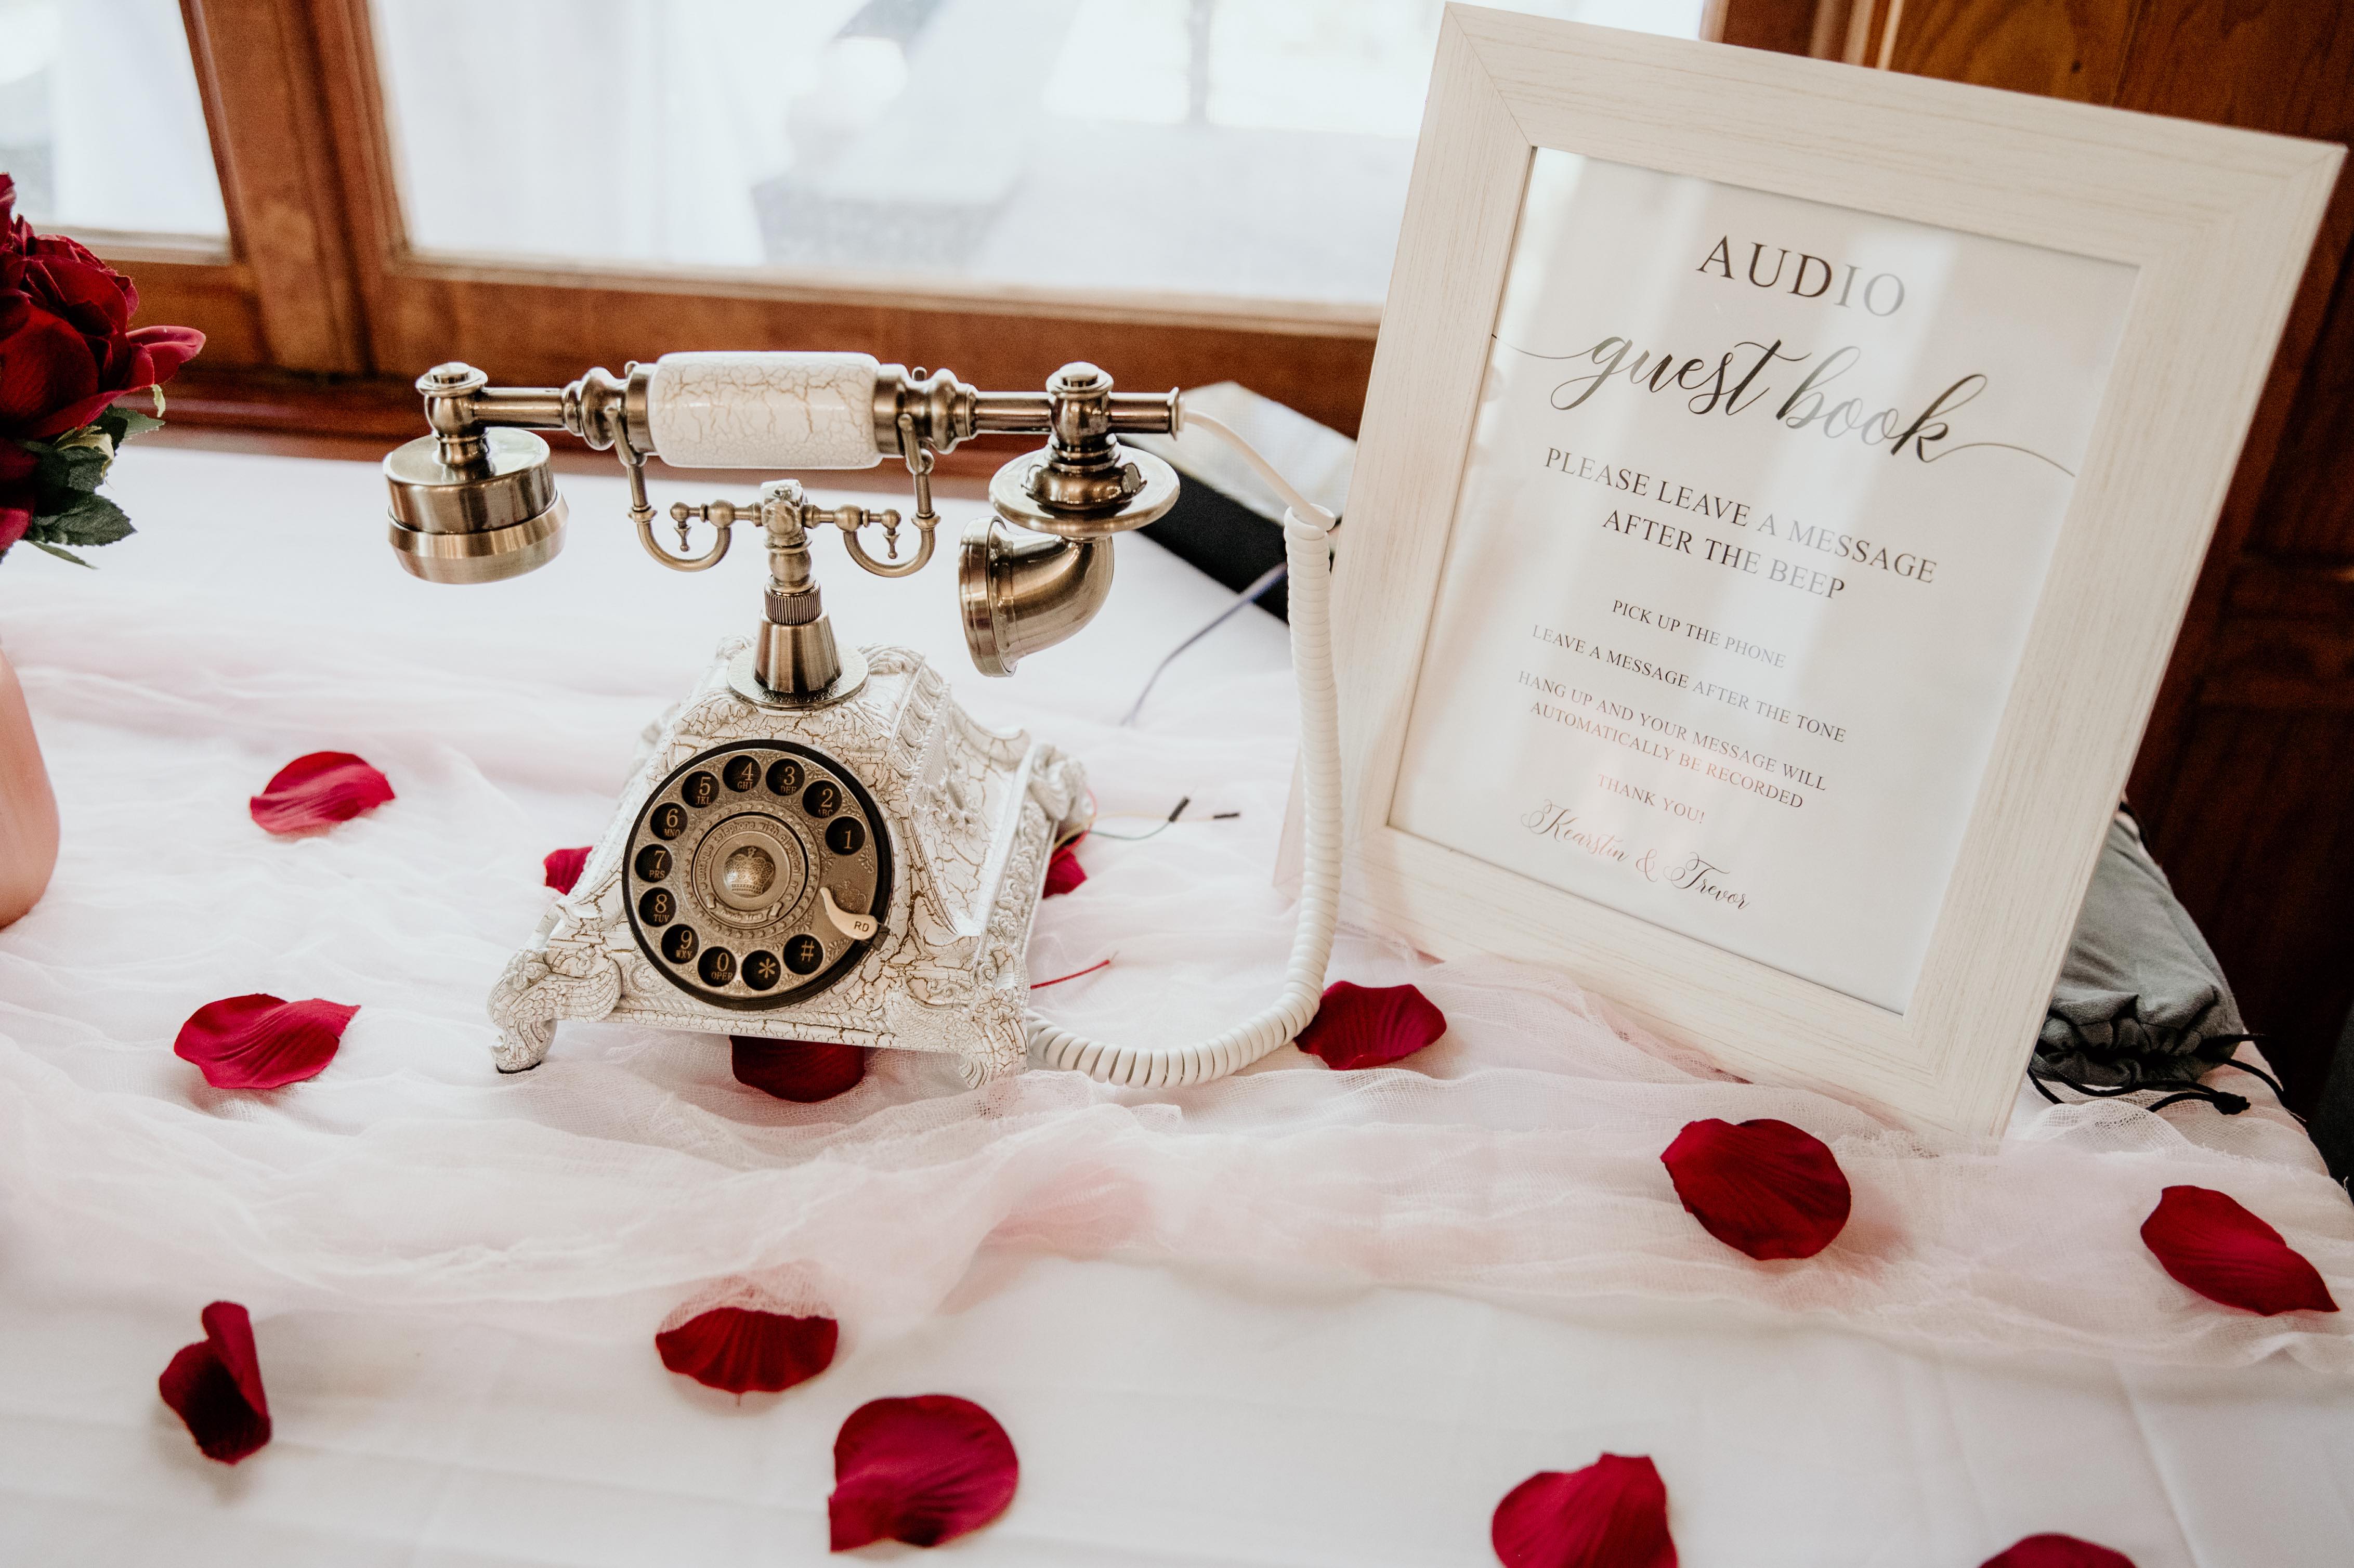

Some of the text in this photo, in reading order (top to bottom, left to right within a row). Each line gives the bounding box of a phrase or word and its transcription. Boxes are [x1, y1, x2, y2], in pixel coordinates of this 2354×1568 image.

[1696, 234, 1905, 316] AUDIO
[1492, 335, 2075, 463] guest book
[1544, 447, 1938, 584] PLEASE LEAVE A MESSAGE
[1602, 509, 1845, 600] AFTER THE BEEP
[1612, 600, 1786, 669] PICK UP THE PHONE
[1532, 624, 1846, 743] LEAVE A MESSAGE AFTER THE TONE
[1518, 671, 1827, 791] HANG UP AND YOUR MESSAGE WILL
[1530, 701, 1804, 808] AUTOMATICALLY BE RECORDED
[741, 762, 753, 780] 4
[783, 766, 795, 785] 3
[699, 777, 711, 795] 5
[737, 781, 753, 790] GHI
[781, 786, 796, 794] DEF
[696, 796, 711, 805] JKL
[821, 788, 833, 807] 2
[1598, 774, 1706, 824] THANK YOU!
[666, 808, 678, 827] 6
[843, 830, 852, 849] 1
[655, 850, 666, 869] 7
[1521, 799, 1750, 909] Kearstin & Trevor
[649, 870, 665, 879] PRS
[655, 894, 668, 913] 8
[854, 921, 869, 932] RD
[681, 930, 692, 949] 9
[676, 950, 692, 959] WXY
[801, 940, 814, 962] #
[717, 952, 729, 972] 0
[711, 972, 733, 981] OPER
